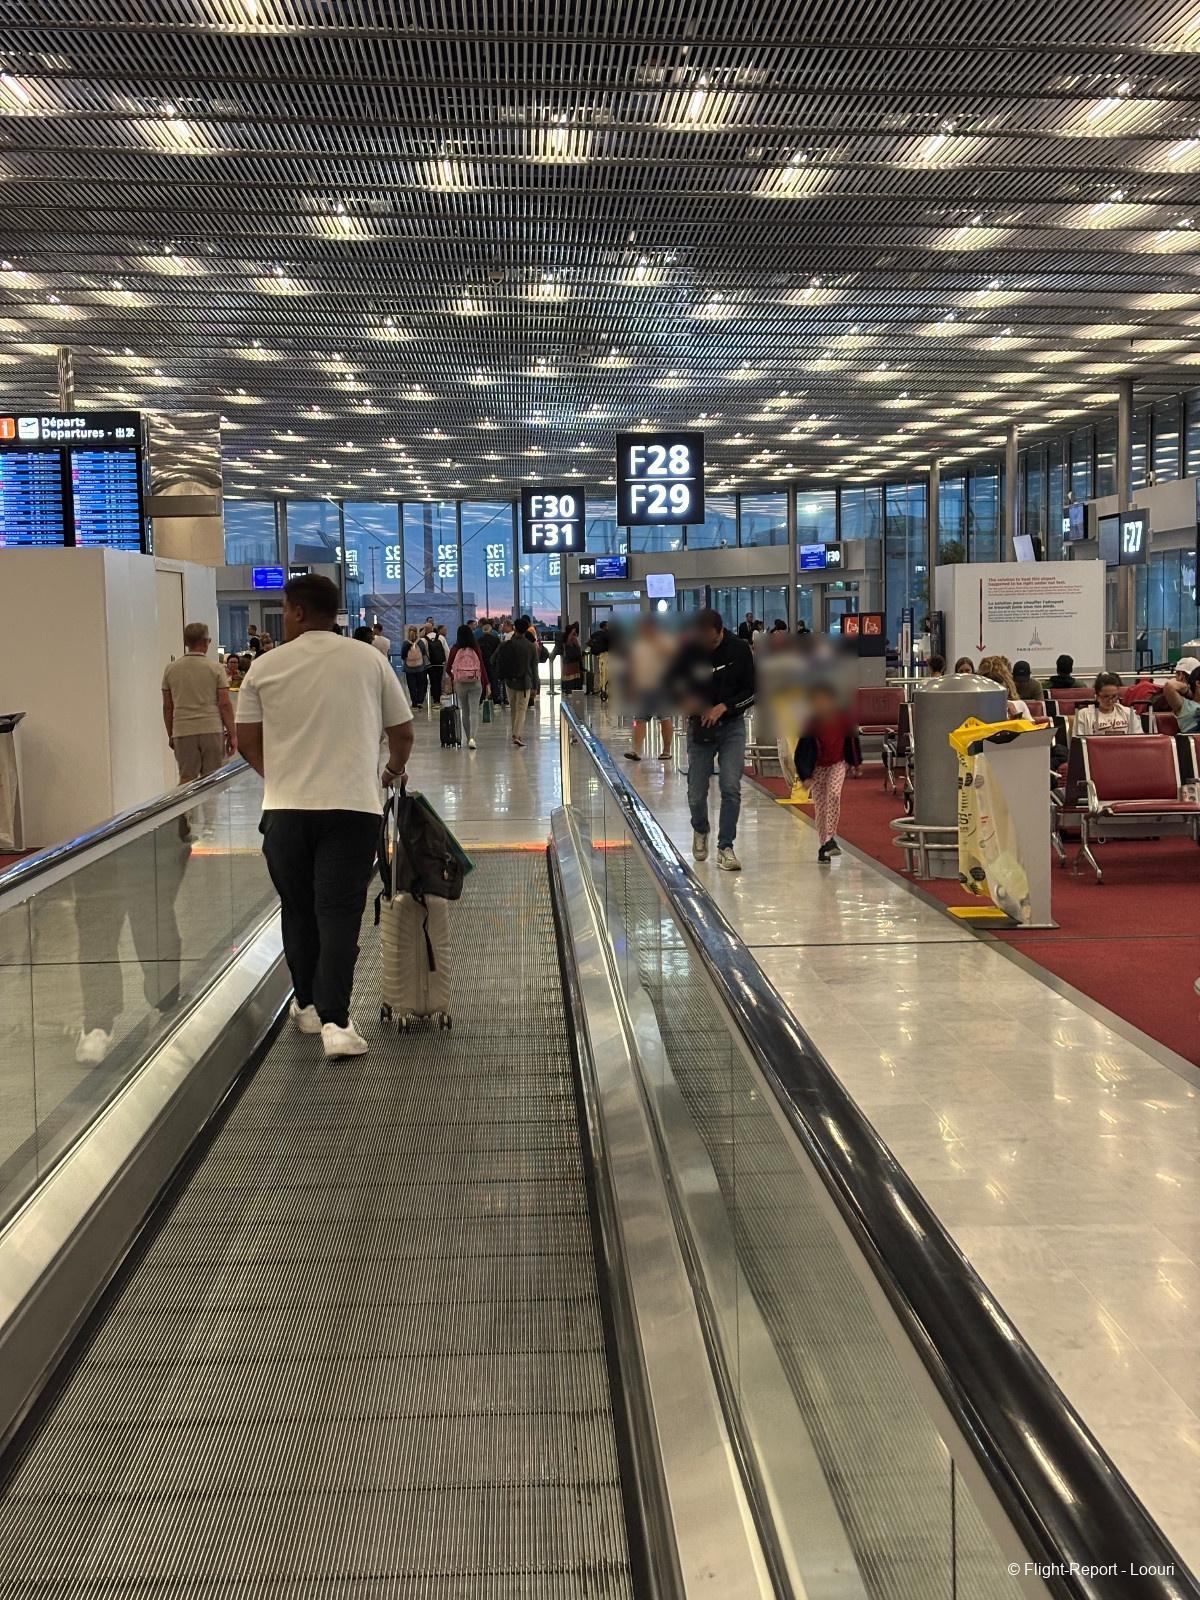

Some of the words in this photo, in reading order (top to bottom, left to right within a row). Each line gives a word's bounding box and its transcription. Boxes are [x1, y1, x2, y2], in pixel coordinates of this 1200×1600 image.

[42, 417, 85, 430] Départs
[42, 429, 104, 440] Departures
[630, 445, 690, 475] F28
[531, 495, 575, 518] F30
[631, 484, 690, 514] F29
[531, 523, 573, 545] F31
[1123, 521, 1142, 552] F27
[827, 551, 840, 562] F30
[580, 564, 595, 575] F31
